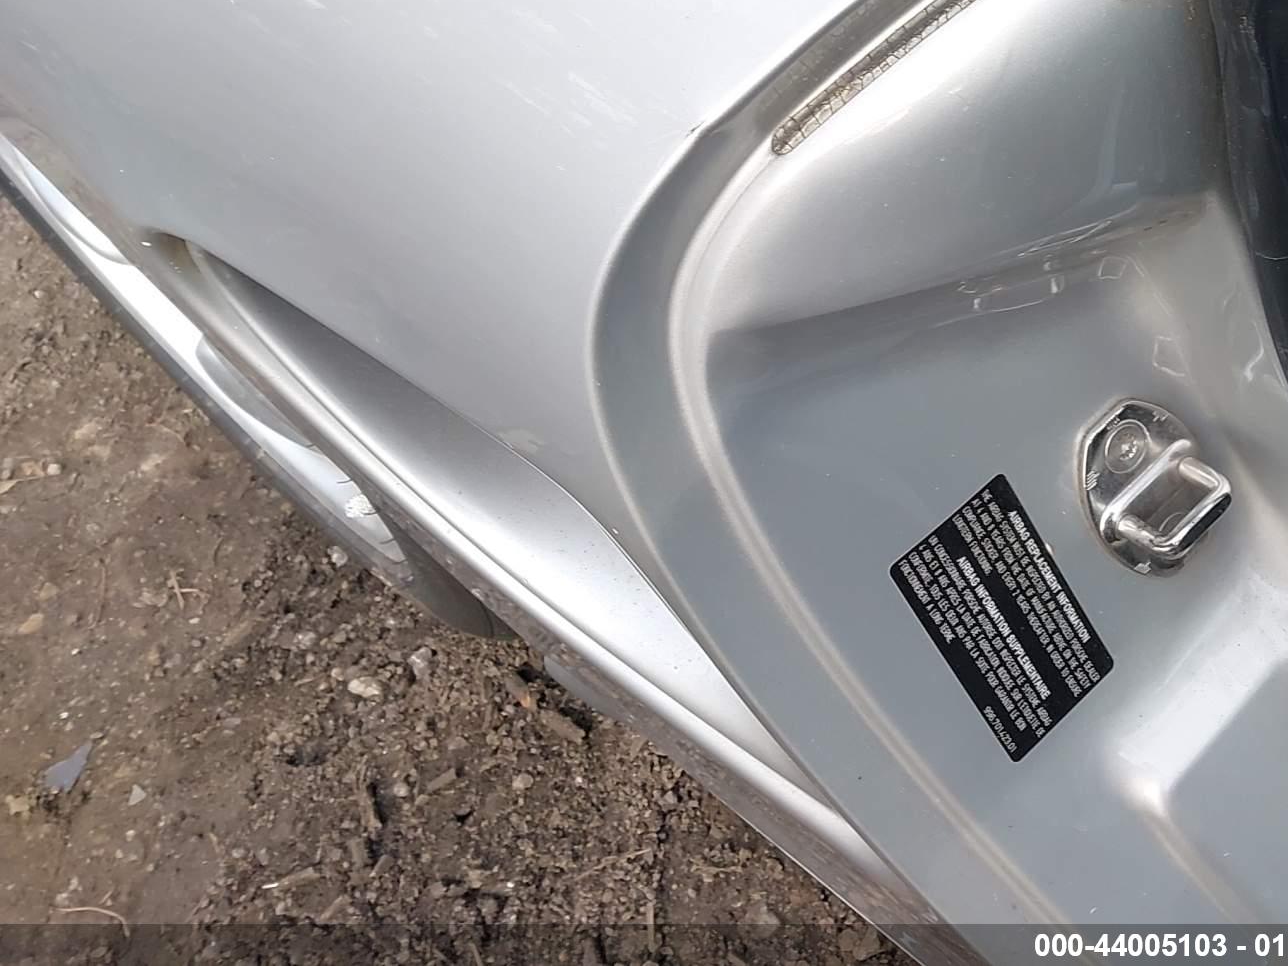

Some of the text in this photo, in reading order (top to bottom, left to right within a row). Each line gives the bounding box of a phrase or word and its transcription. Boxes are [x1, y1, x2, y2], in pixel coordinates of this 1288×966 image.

[999, 520, 1017, 544] SYSTEM
[1007, 510, 1091, 644] AIRBAG REPLACEMENT INFORMATION
[956, 556, 1051, 700] AIRBAG INFORMATION SUPPLEMENTAIRE
